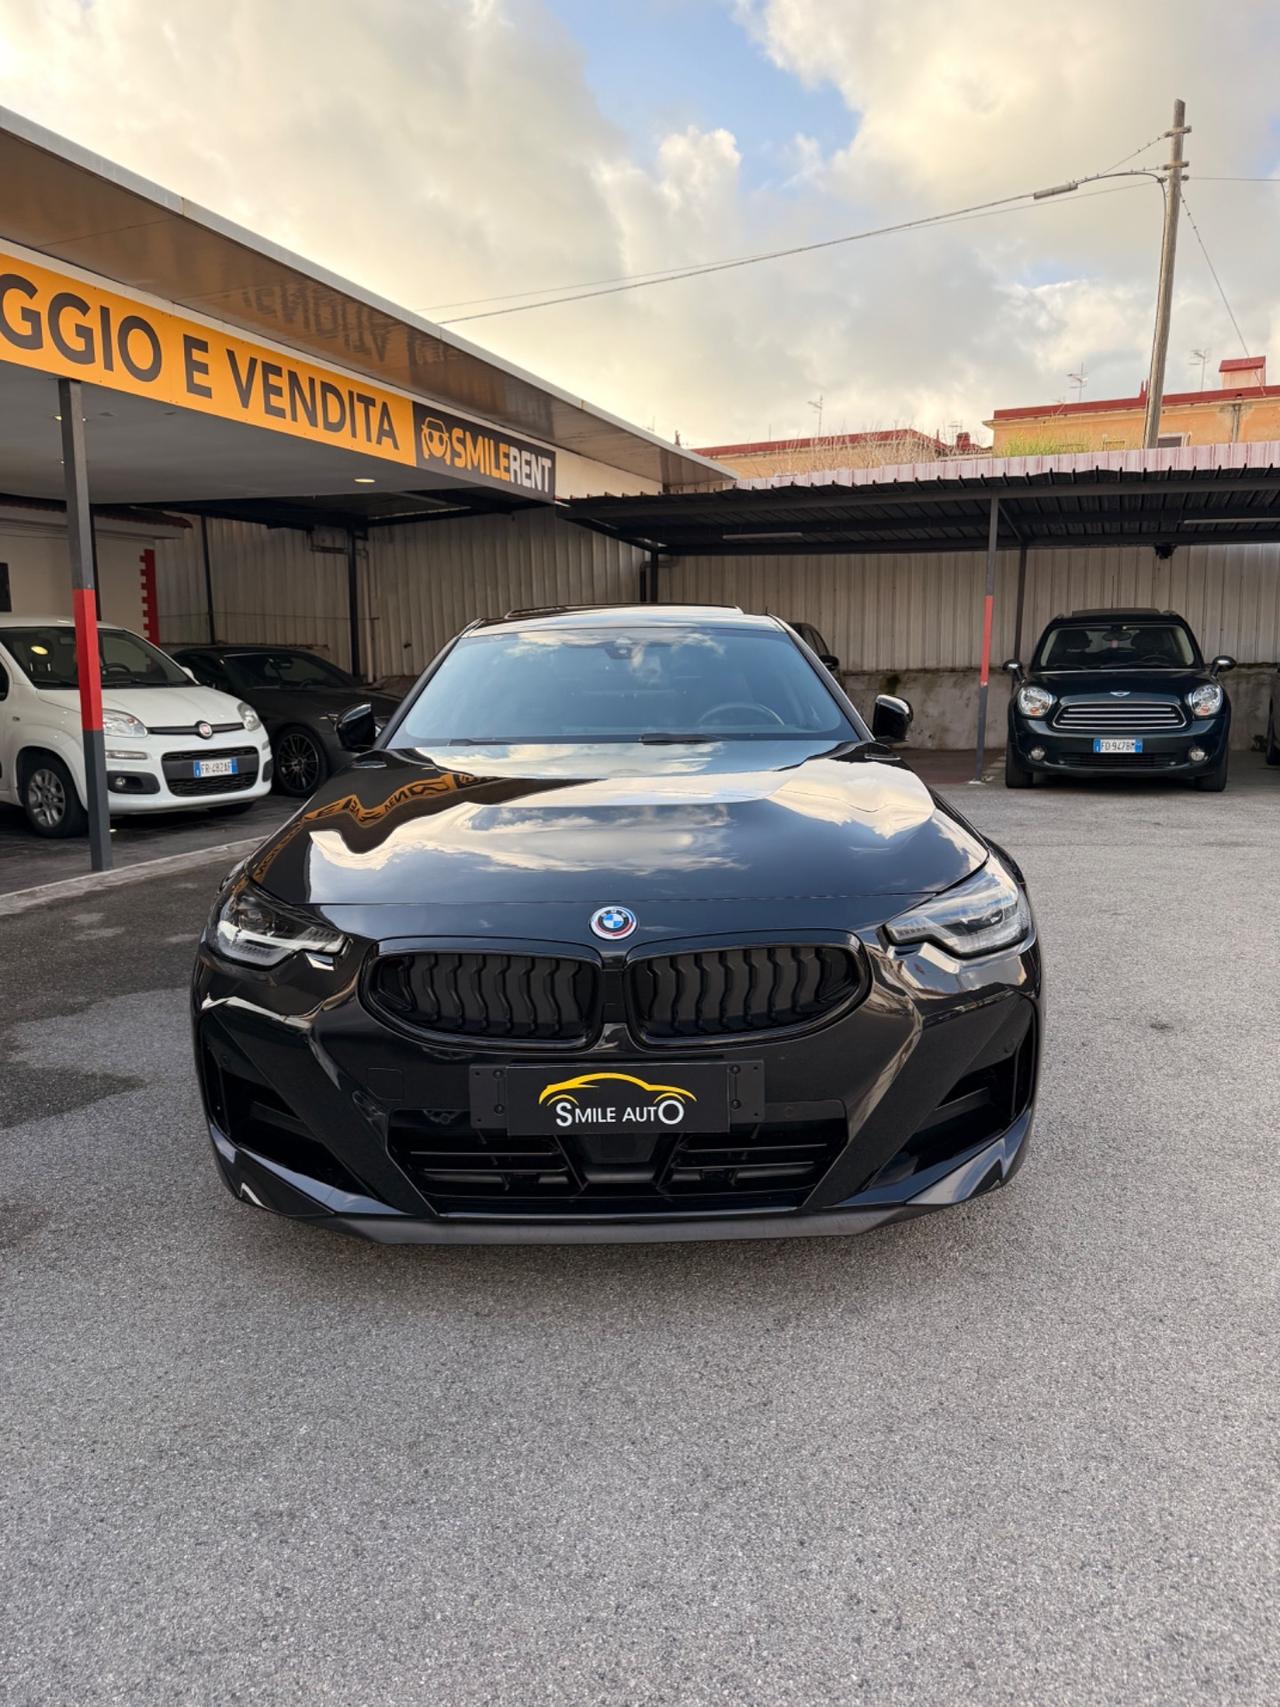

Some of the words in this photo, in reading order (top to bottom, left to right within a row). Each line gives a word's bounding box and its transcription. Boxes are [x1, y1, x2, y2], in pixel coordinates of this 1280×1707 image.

[0, 273, 163, 383] GGIO
[183, 333, 213, 399] E
[225, 348, 400, 450] VENDITA
[451, 427, 552, 493] SMILERENT
[555, 1101, 617, 1127] SMILE
[622, 1099, 684, 1125] AUTO
